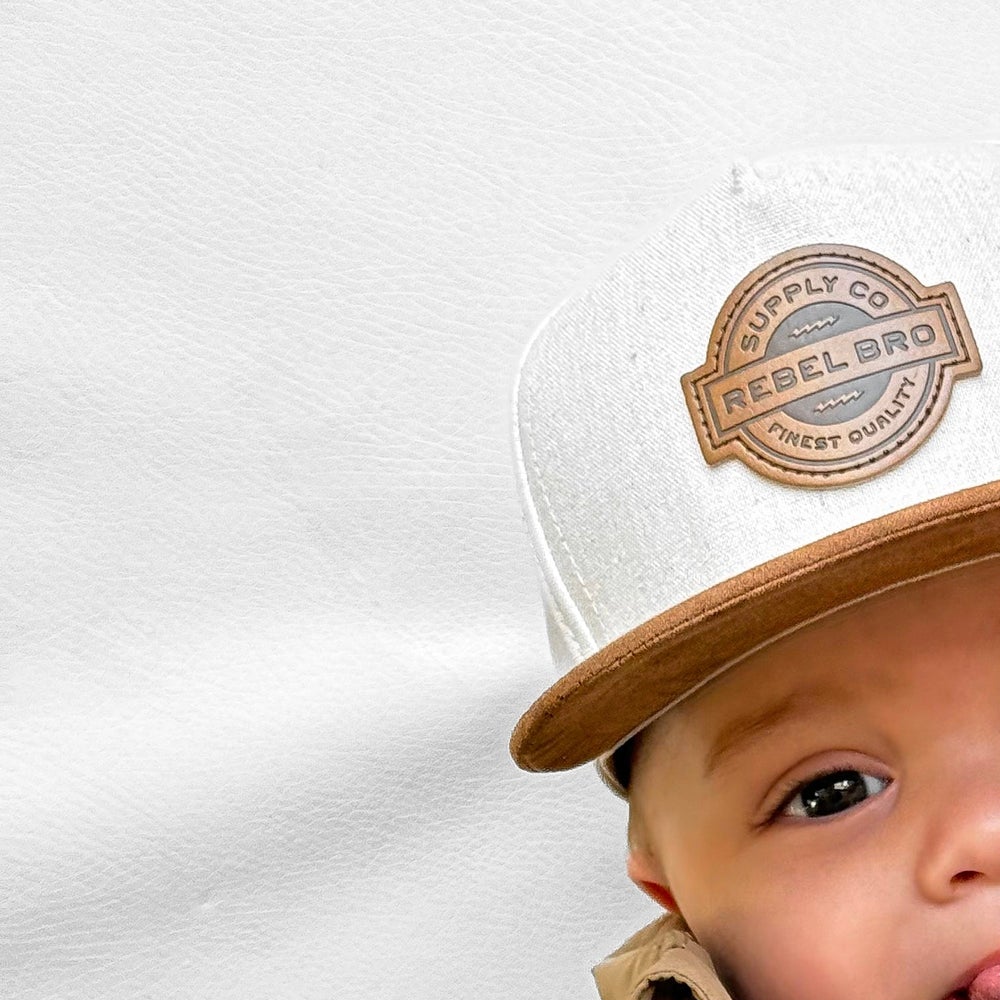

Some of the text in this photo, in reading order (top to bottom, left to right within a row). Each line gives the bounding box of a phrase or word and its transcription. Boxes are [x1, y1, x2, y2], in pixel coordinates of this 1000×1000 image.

[740, 275, 890, 353] SUPPLY CO
[721, 323, 937, 415] REBEL BRO
[767, 375, 916, 450] FINEST QUALITY
